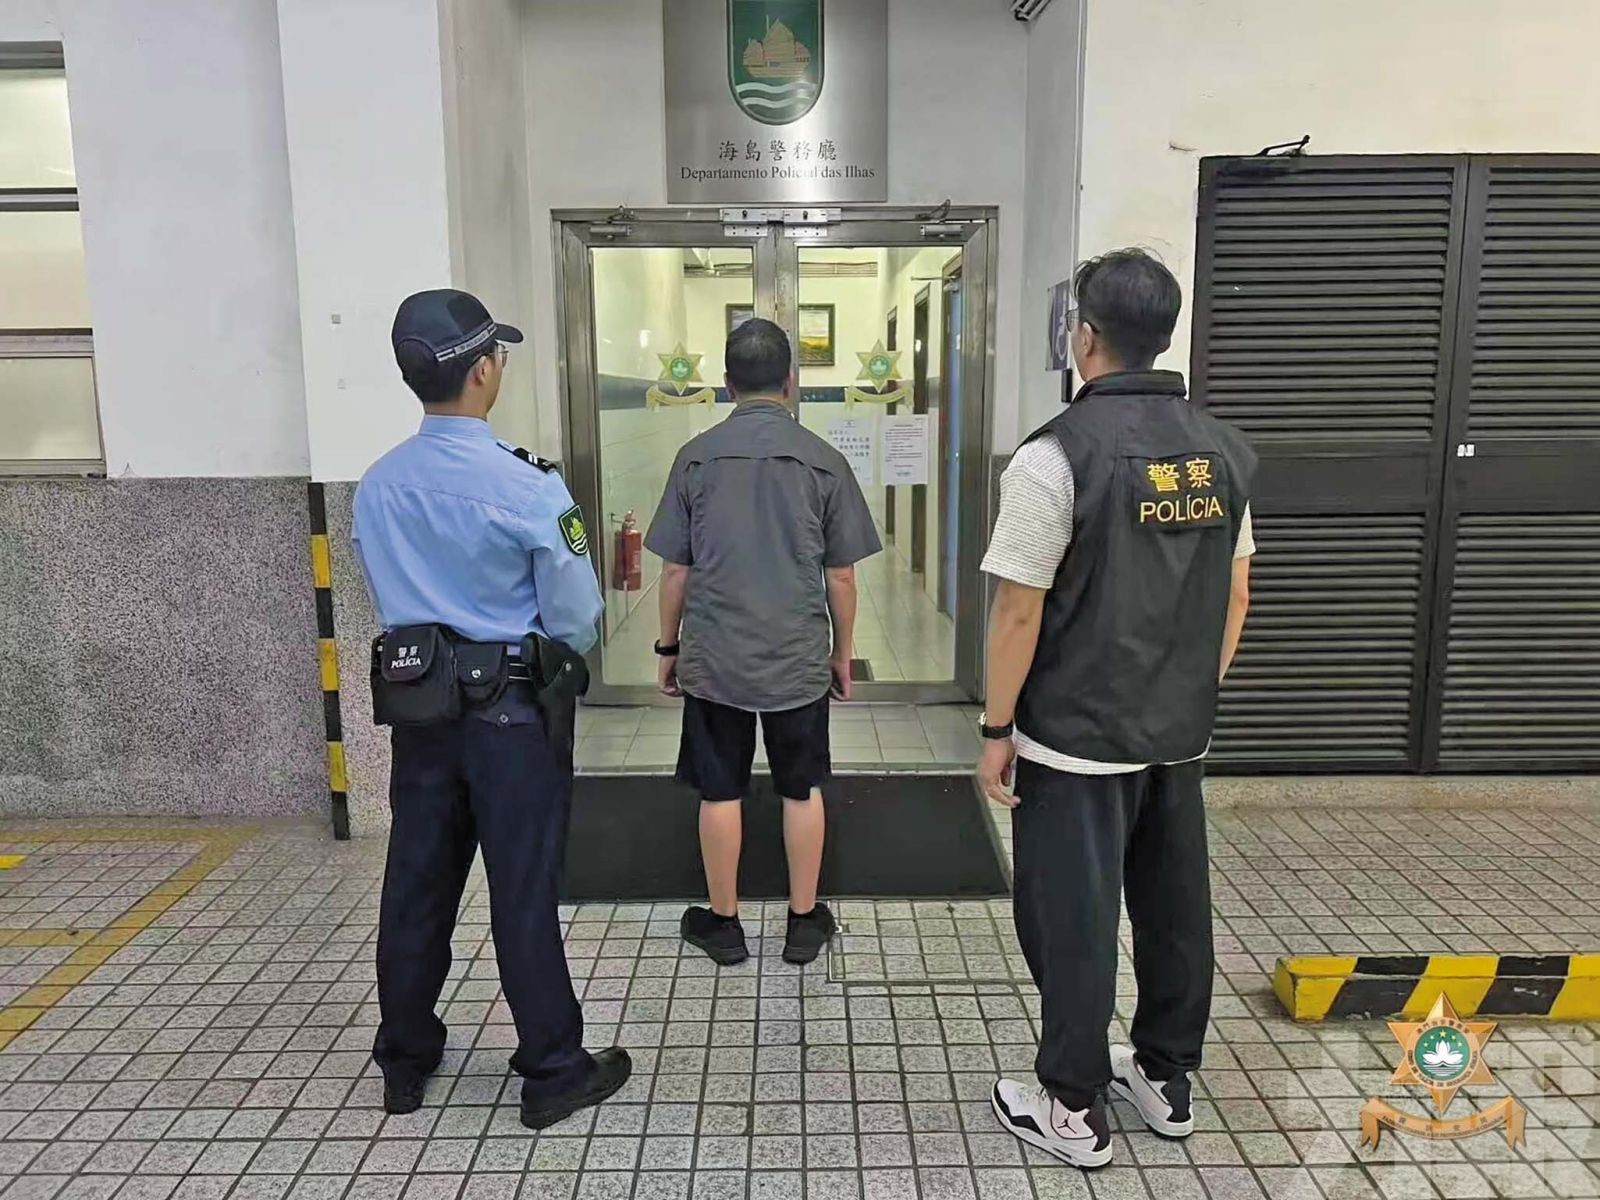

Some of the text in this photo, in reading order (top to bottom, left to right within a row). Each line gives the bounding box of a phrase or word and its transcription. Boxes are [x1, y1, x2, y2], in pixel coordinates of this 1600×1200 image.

[719, 139, 837, 162] 海島警務廳
[681, 167, 767, 182] Departamento
[821, 166, 841, 179] das
[845, 165, 875, 179] Ilhas
[1147, 458, 1212, 492] 警察
[1140, 494, 1224, 523] POLÍCIA
[391, 657, 421, 668] POLÍCIA
